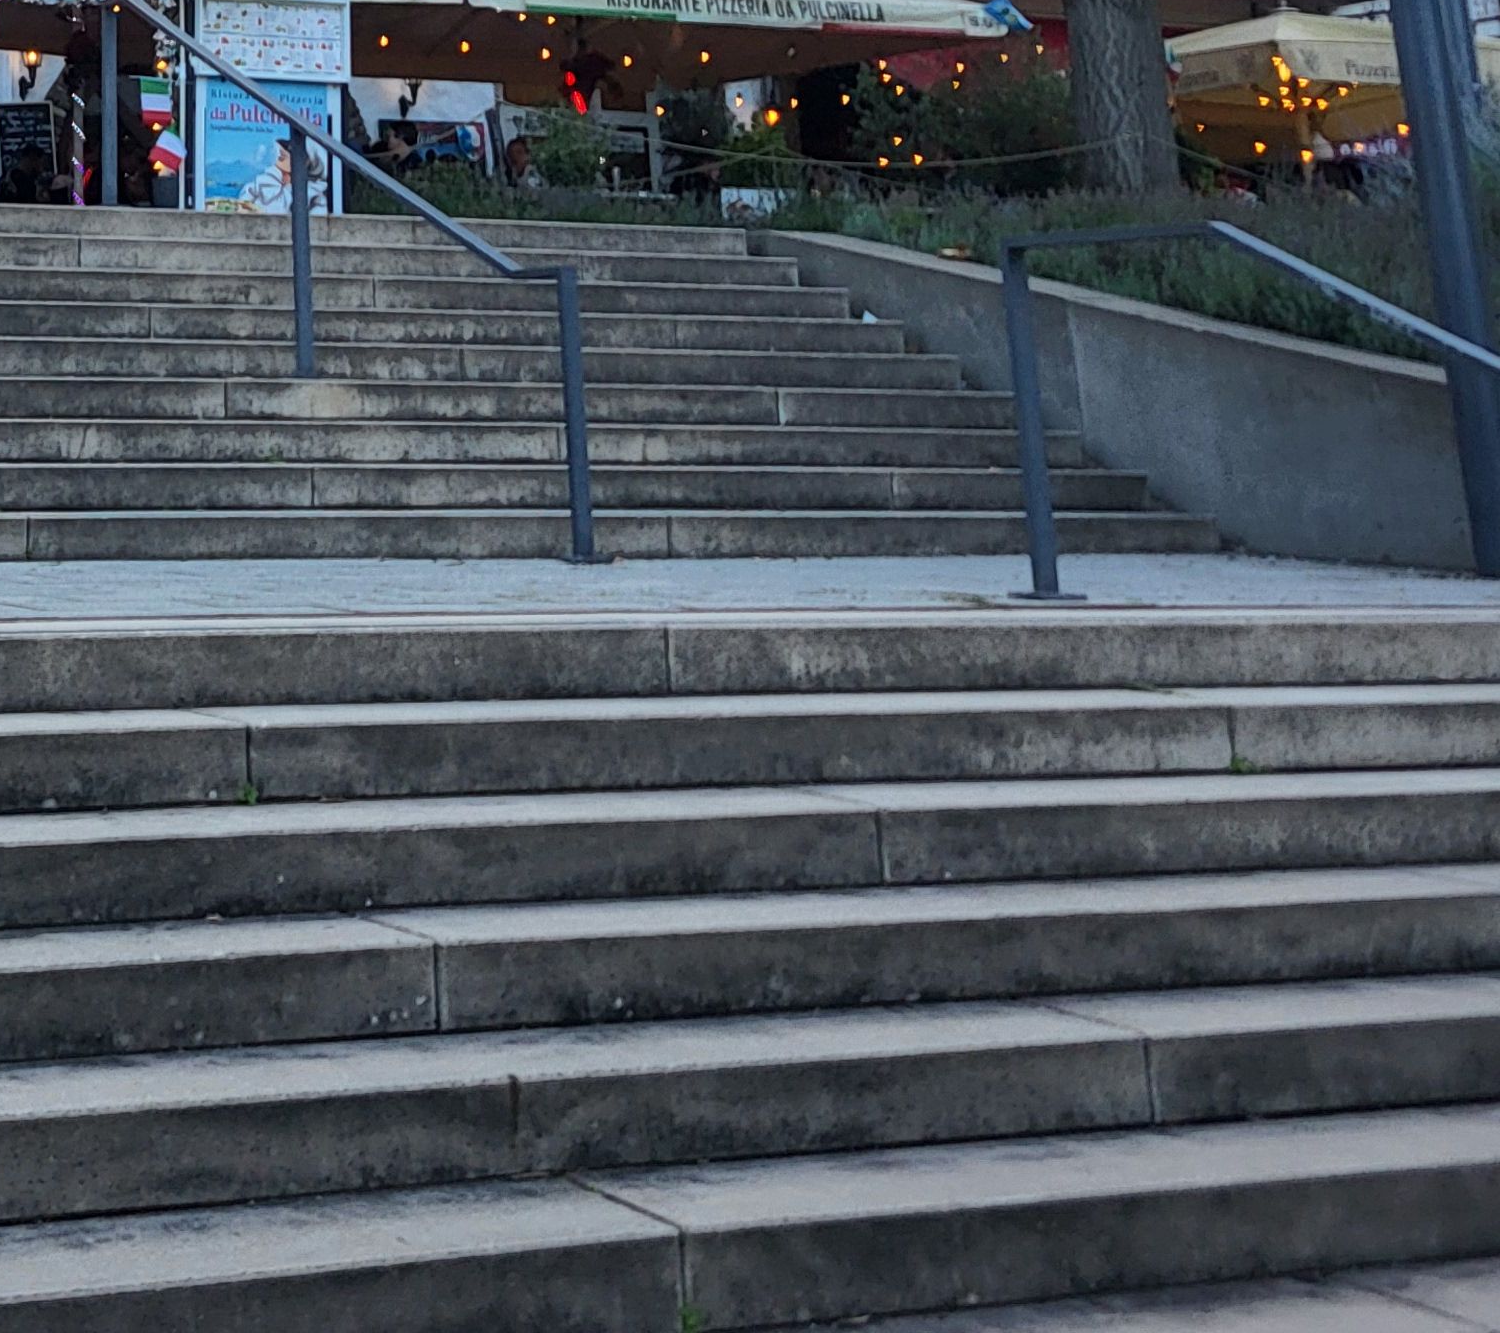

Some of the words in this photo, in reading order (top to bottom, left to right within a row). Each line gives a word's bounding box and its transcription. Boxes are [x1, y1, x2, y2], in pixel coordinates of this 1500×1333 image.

[775, 0, 794, 19] DA
[799, 0, 886, 22] PULCINELLA
[210, 106, 227, 121] da
